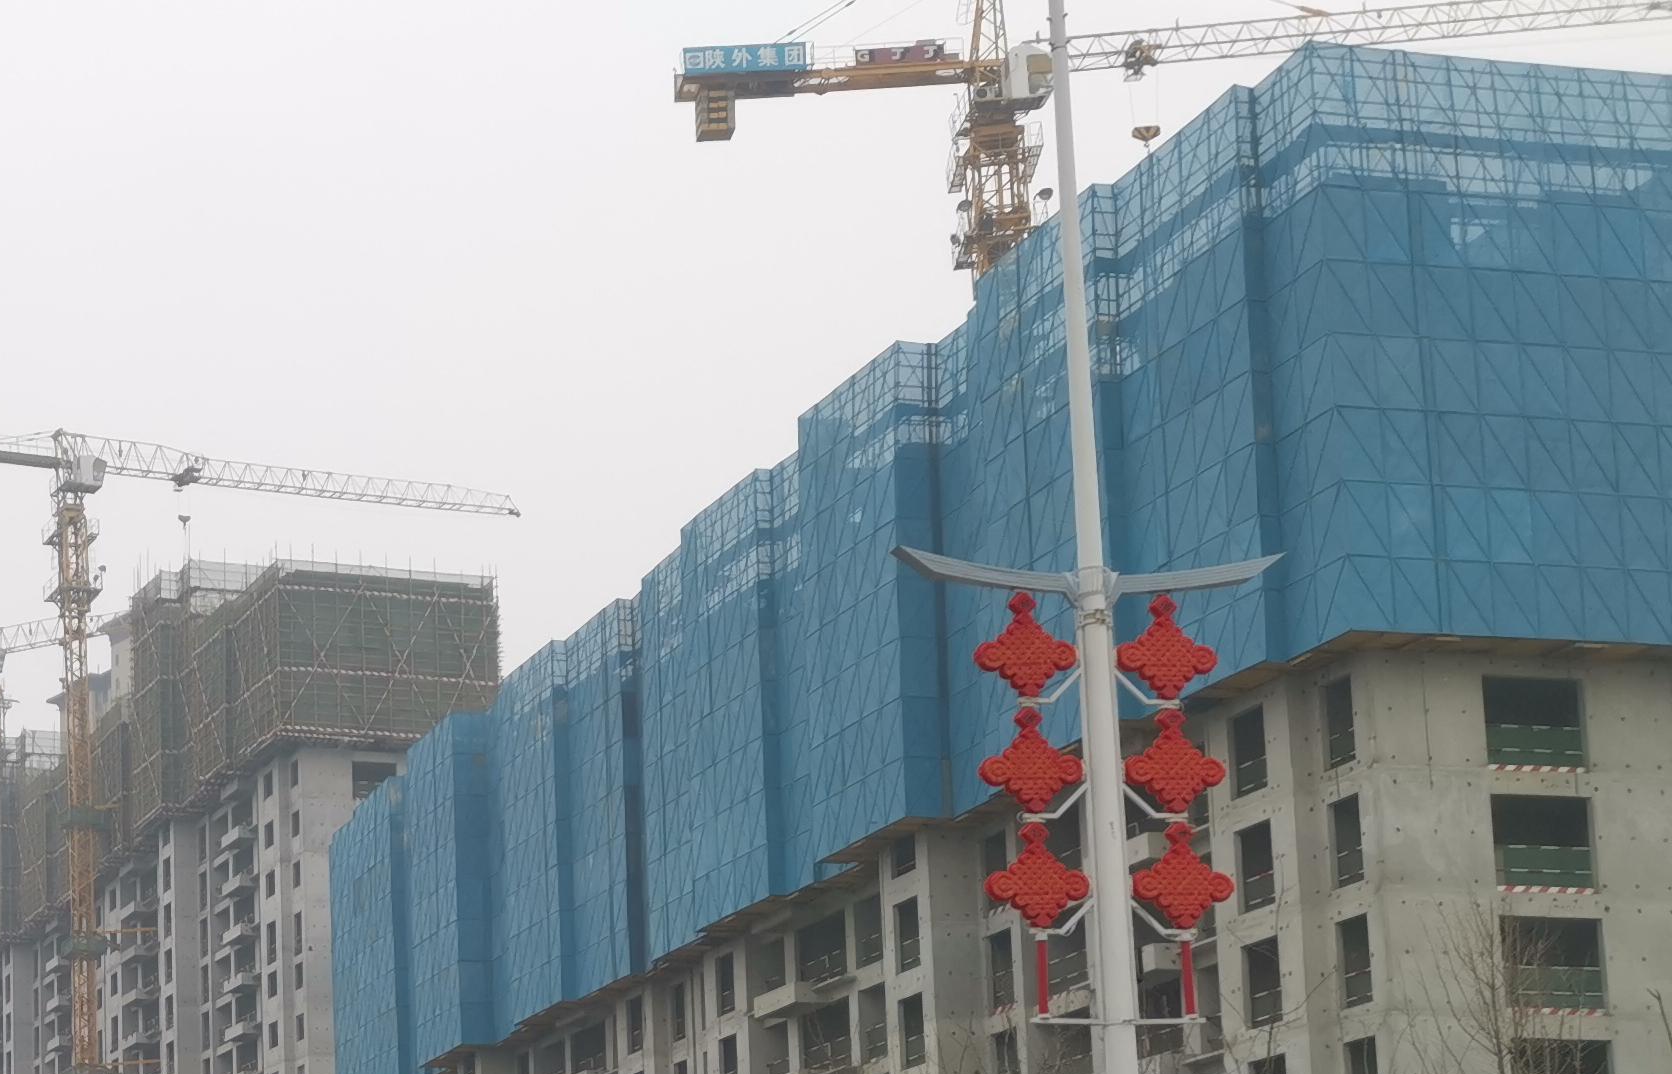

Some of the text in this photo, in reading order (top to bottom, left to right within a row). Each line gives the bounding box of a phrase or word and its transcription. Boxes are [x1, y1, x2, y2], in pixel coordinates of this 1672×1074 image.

[705, 46, 804, 69] 陕外集团
[857, 46, 937, 62] GJJ
